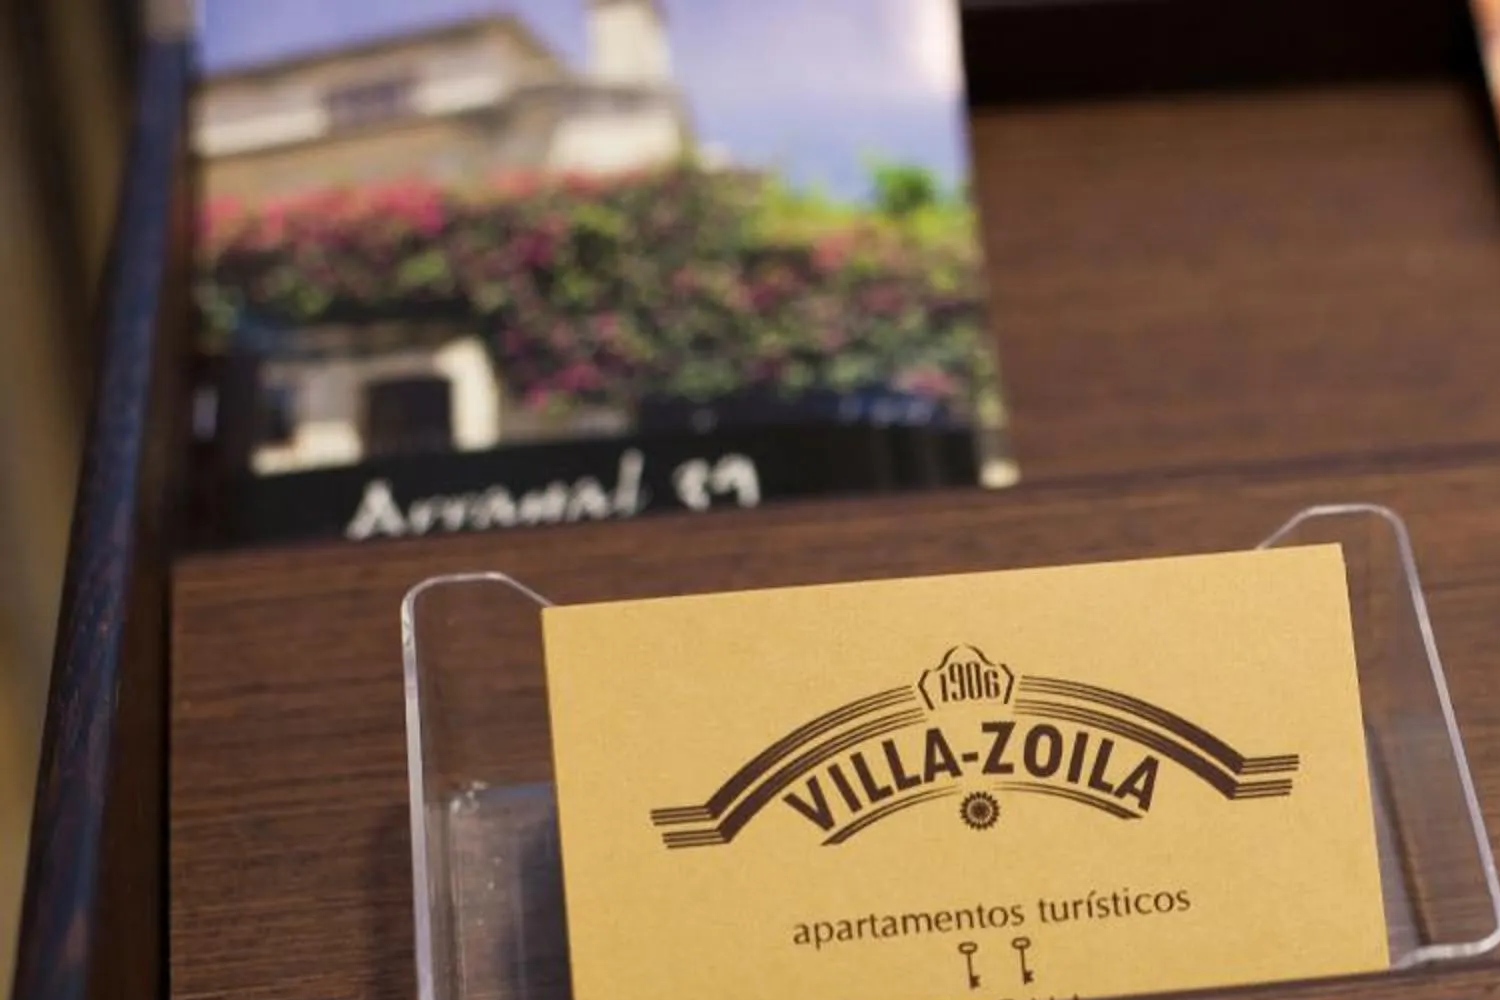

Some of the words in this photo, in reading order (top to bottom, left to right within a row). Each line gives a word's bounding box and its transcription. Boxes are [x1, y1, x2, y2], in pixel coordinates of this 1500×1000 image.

[939, 660, 1001, 702] 1906
[783, 720, 1160, 832] VILLA-ZOILA
[792, 903, 1025, 950] apartamentos
[1038, 886, 1192, 924] turísticos
